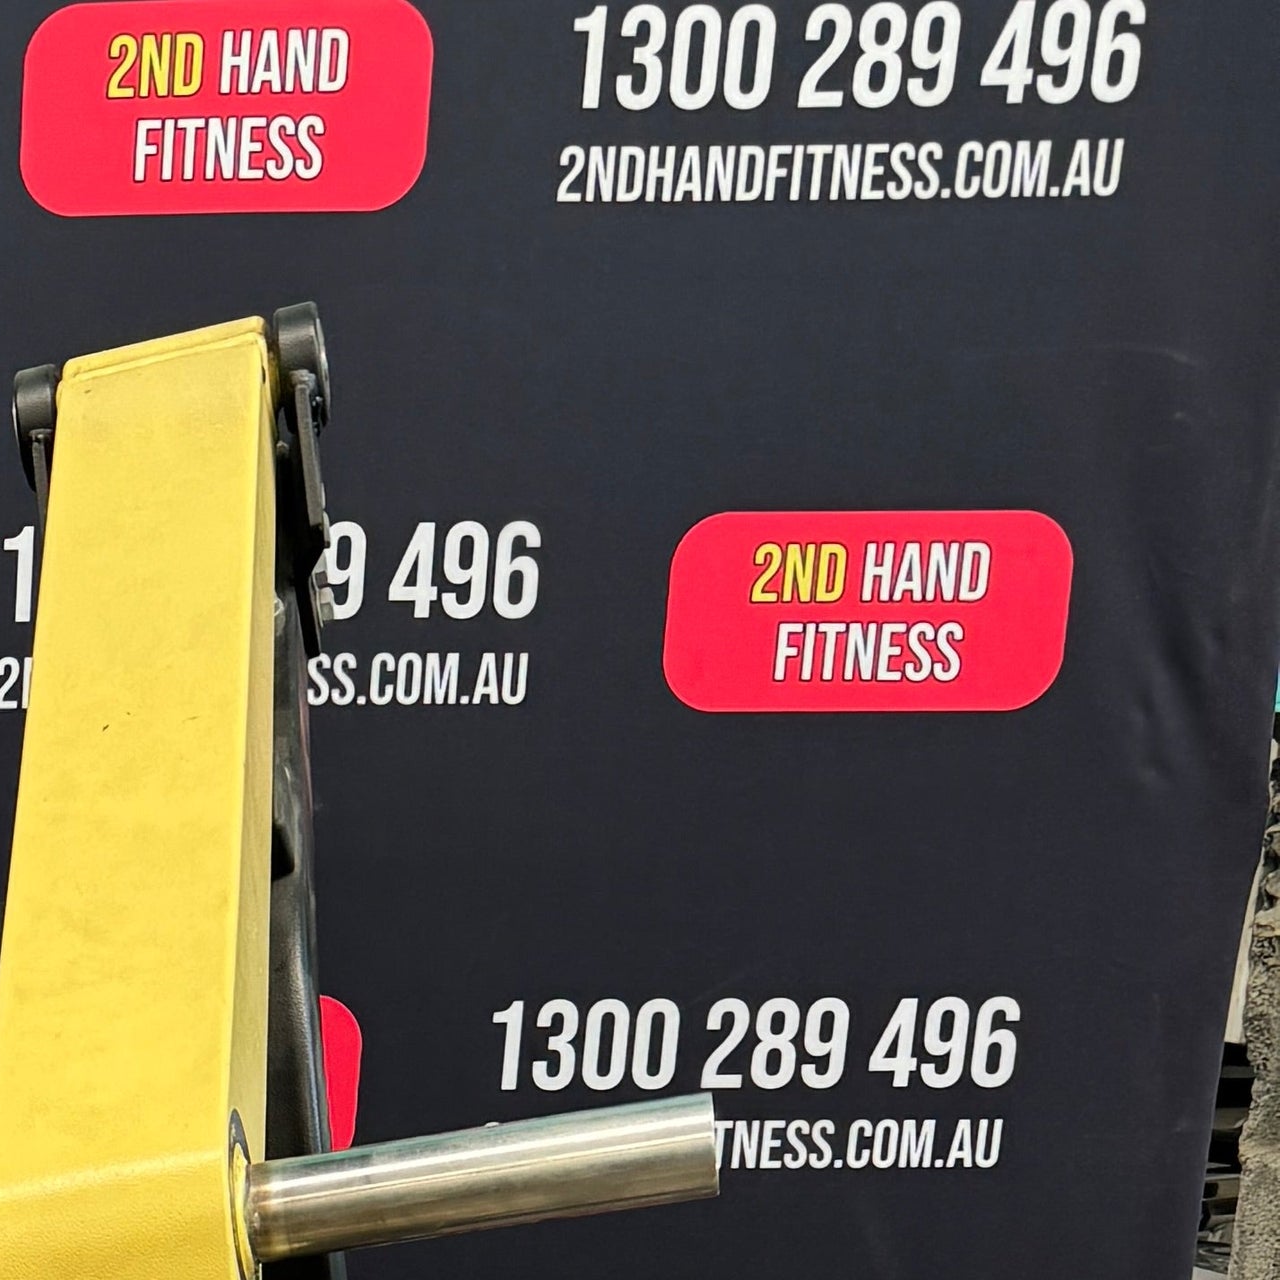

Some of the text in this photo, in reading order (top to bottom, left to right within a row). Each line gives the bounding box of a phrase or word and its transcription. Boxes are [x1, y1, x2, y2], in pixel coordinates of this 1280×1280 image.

[108, 29, 348, 97] 2ND HAND
[574, 0, 1146, 110] 1300 289 496
[135, 116, 324, 180] FITNESS
[557, 138, 1124, 202] 2NDHANDFITNESS.COM.AU
[388, 521, 541, 619] 496
[752, 543, 990, 601] 2ND HAND
[775, 623, 963, 681] FITNESS
[493, 996, 1020, 1091] 1300 289 496
